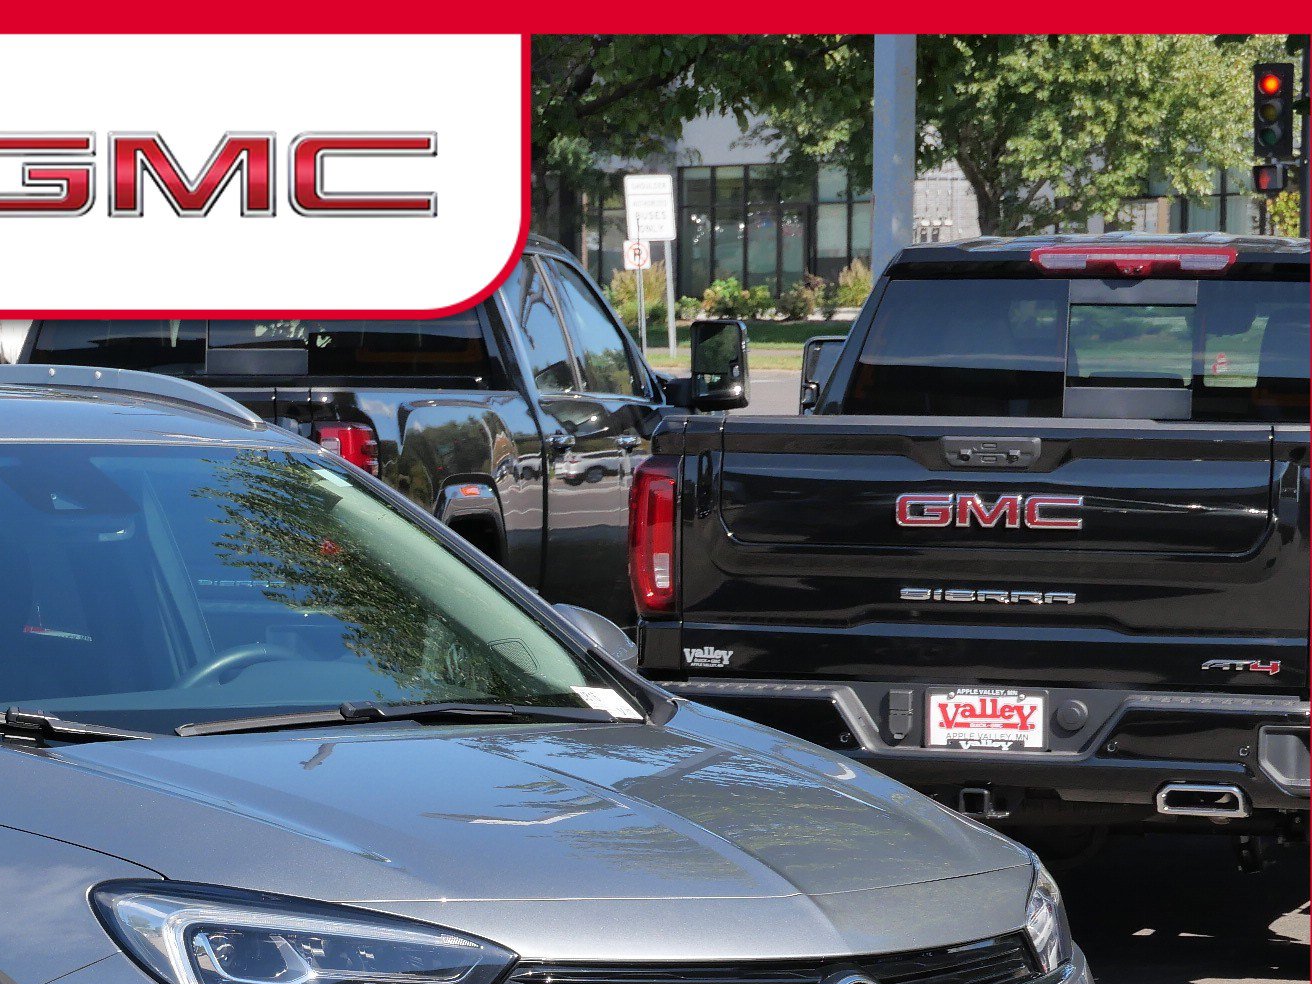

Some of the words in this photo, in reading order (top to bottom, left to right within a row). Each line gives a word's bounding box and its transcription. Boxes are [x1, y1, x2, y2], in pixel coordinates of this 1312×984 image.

[895, 492, 1084, 530] GMC
[899, 587, 1077, 606] SIERRA
[1201, 658, 1281, 676] AT4
[938, 698, 1038, 731] Valley
